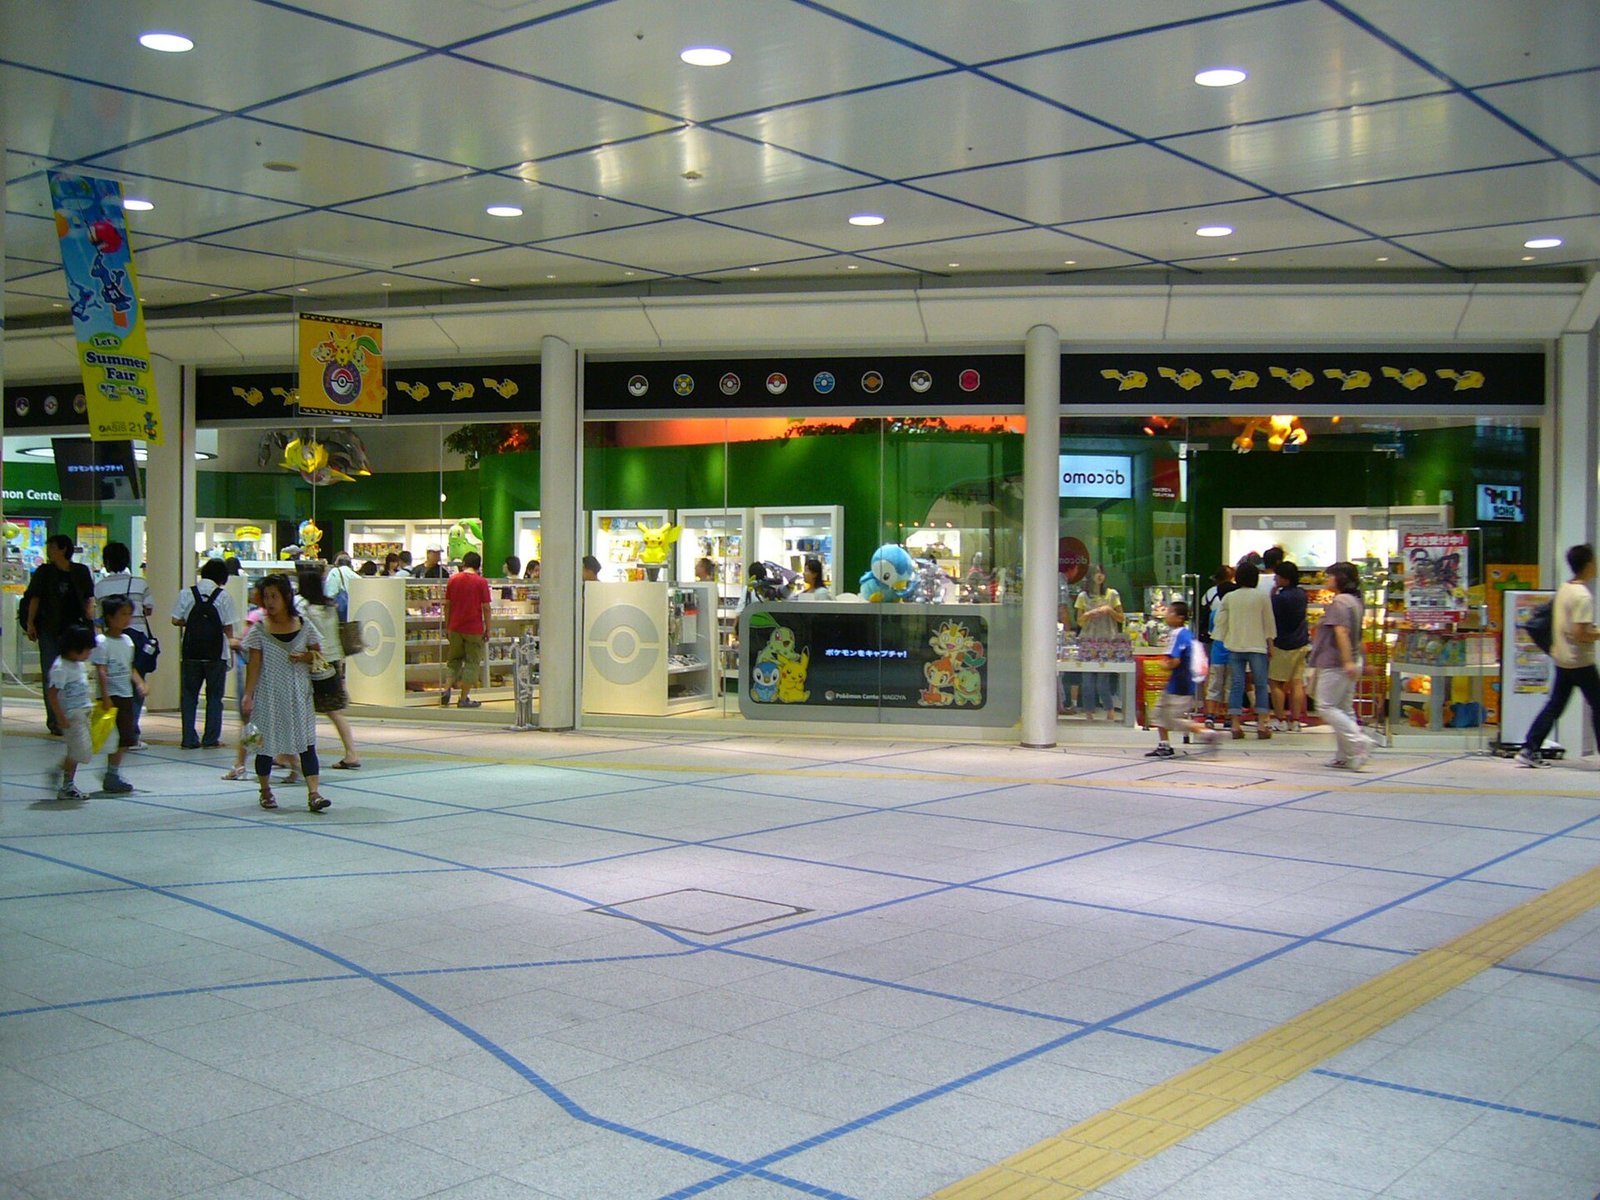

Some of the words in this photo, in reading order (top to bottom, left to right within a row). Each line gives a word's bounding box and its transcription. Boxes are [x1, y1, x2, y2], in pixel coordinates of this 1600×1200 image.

[86, 351, 147, 370] Summer
[106, 367, 137, 381] Fair
[129, 422, 142, 433] 21
[825, 648, 908, 659] ポケモンをキャプチャ!
